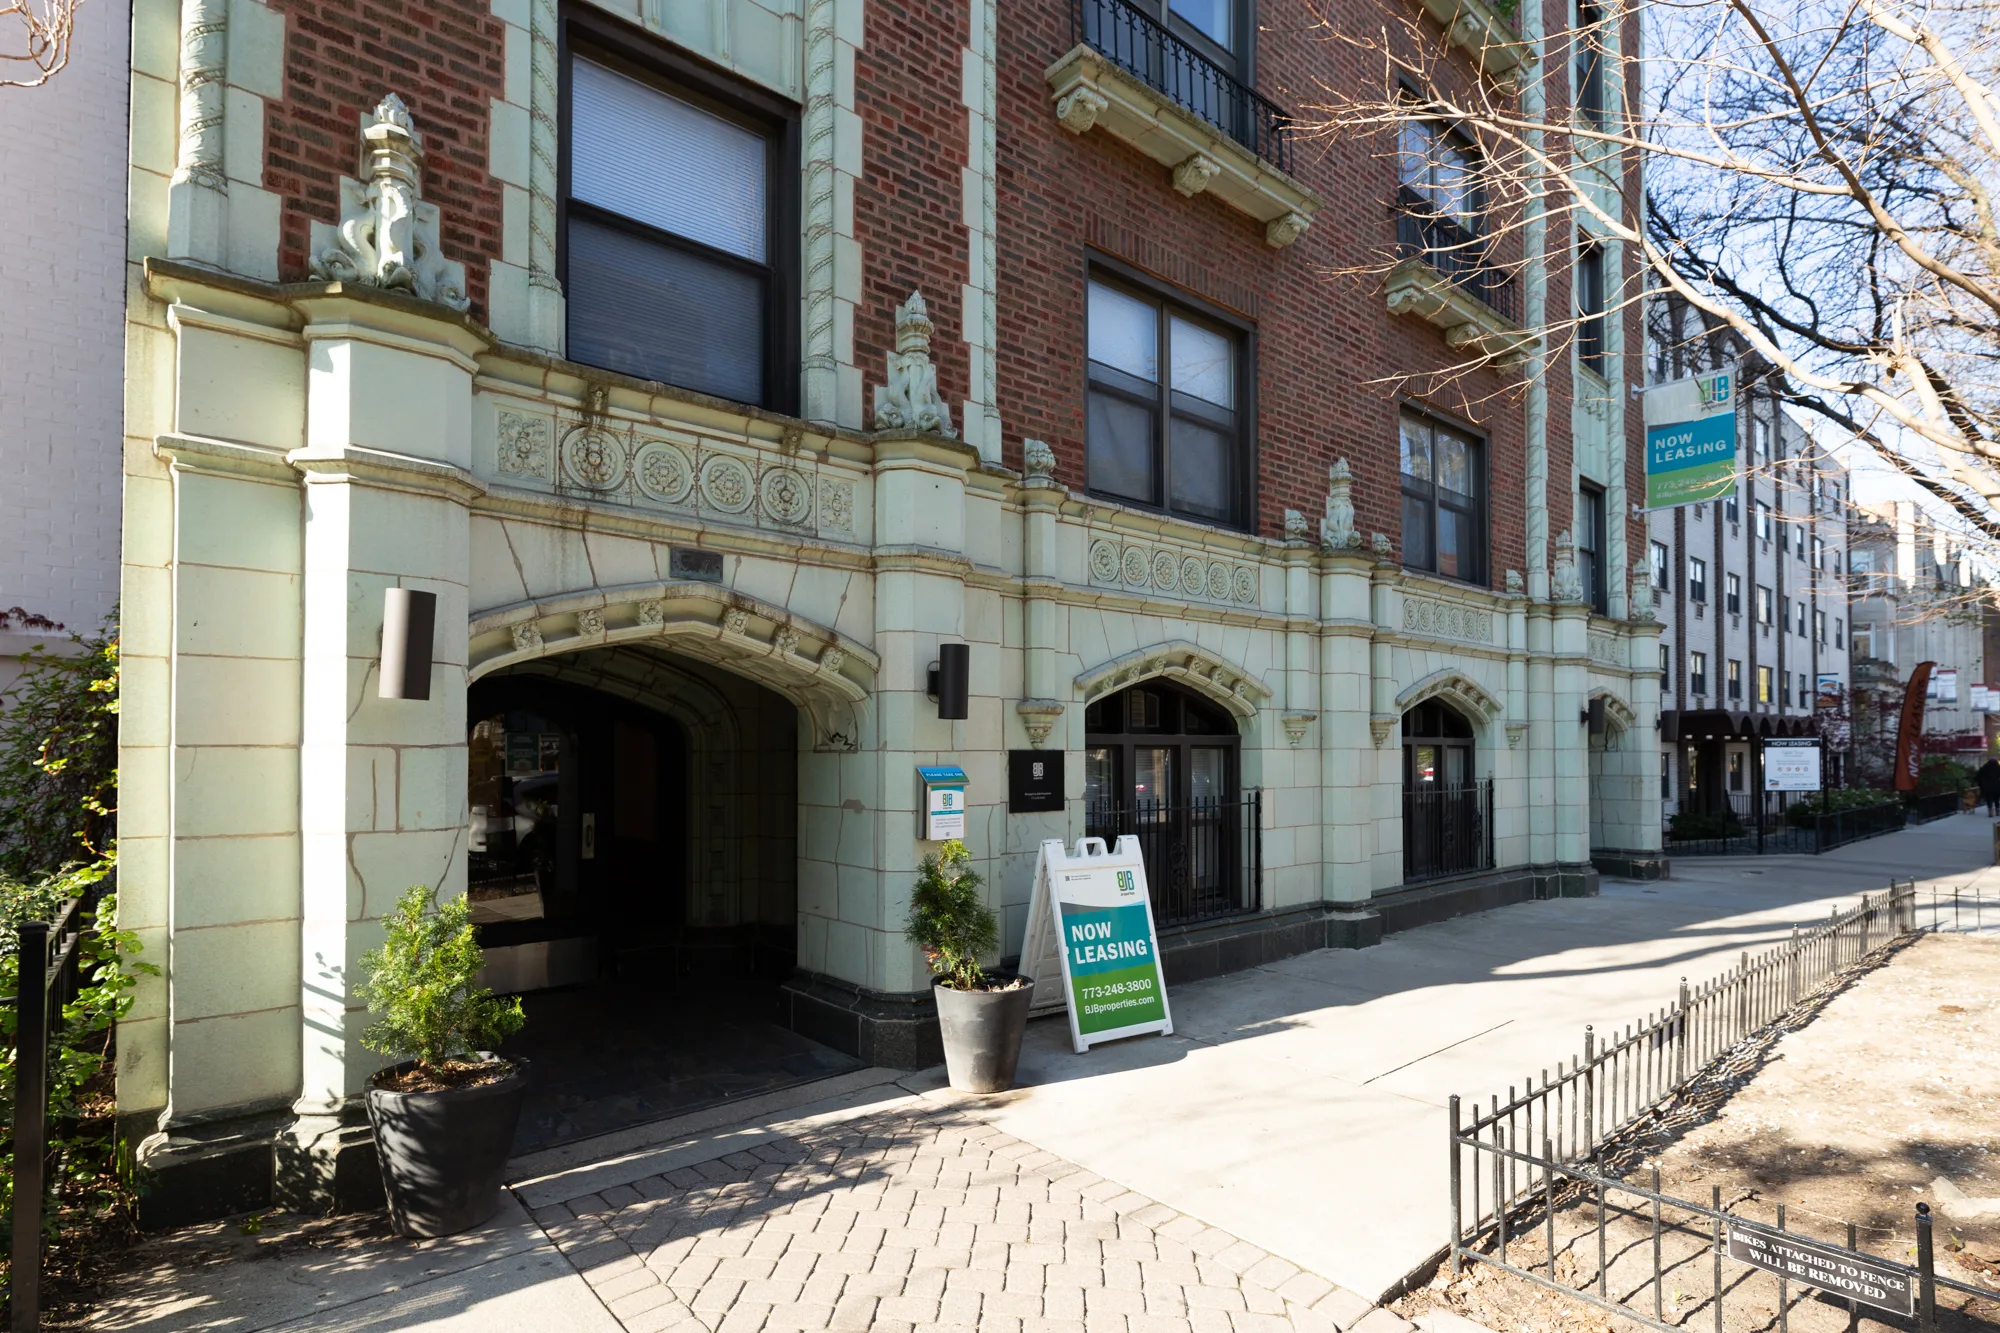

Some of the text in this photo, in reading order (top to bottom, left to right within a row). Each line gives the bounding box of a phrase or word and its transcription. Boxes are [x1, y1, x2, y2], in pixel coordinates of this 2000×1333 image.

[1655, 432, 1693, 450] NOW
[1656, 440, 1727, 464] LEASING
[1907, 678, 1926, 778] NOW LEASING
[1117, 870, 1135, 891] BJB
[1071, 921, 1112, 942] NOW
[1075, 940, 1147, 965] LEASING
[1081, 978, 1152, 1000] 773-248-3800
[1084, 995, 1155, 1015] BJBproperties.com
[1732, 1231, 1905, 1292] BIKES ATTACHED TO FENCE
[1748, 1248, 1887, 1300] WILL BE REMOVED
